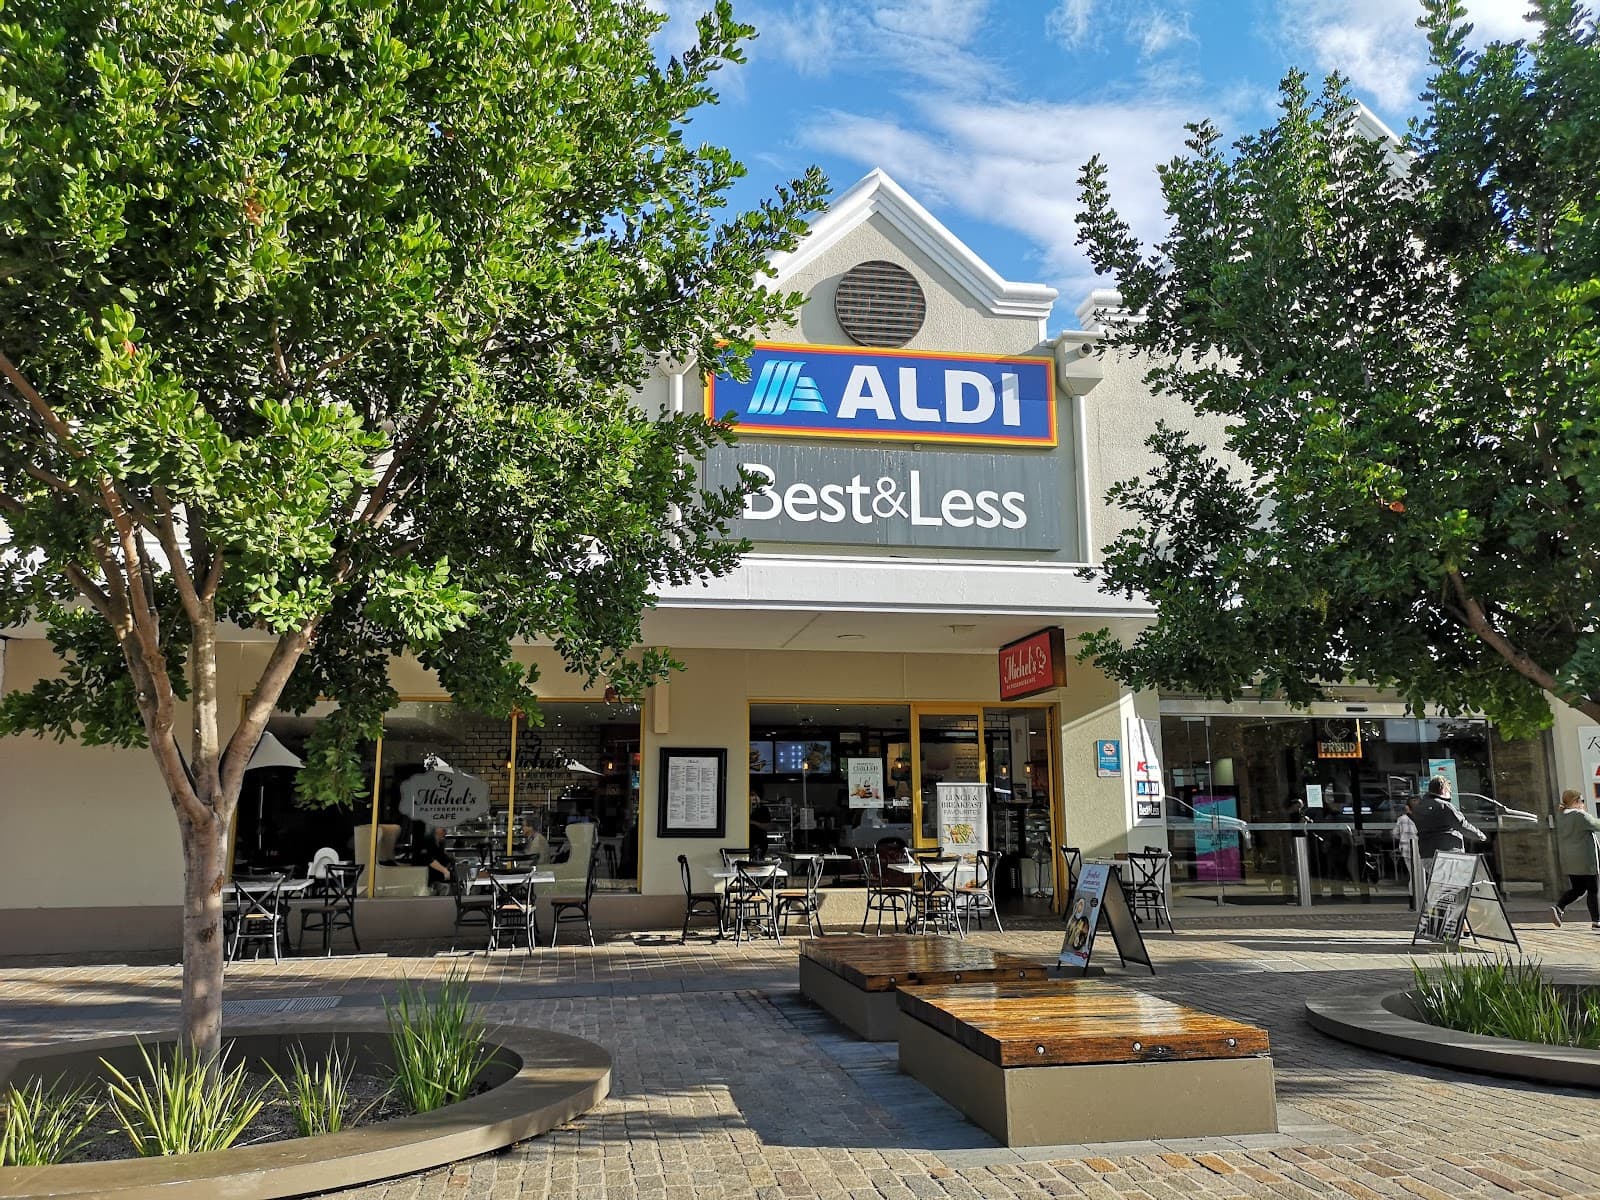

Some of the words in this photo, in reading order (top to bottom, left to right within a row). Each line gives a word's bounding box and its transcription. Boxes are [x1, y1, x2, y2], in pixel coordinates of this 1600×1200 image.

[836, 365, 1021, 426] ALDI
[742, 463, 1028, 530] Best&Less
[1004, 646, 1037, 684] Michel's
[414, 787, 477, 806] Michel's
[941, 801, 983, 809] BREAKFAST
